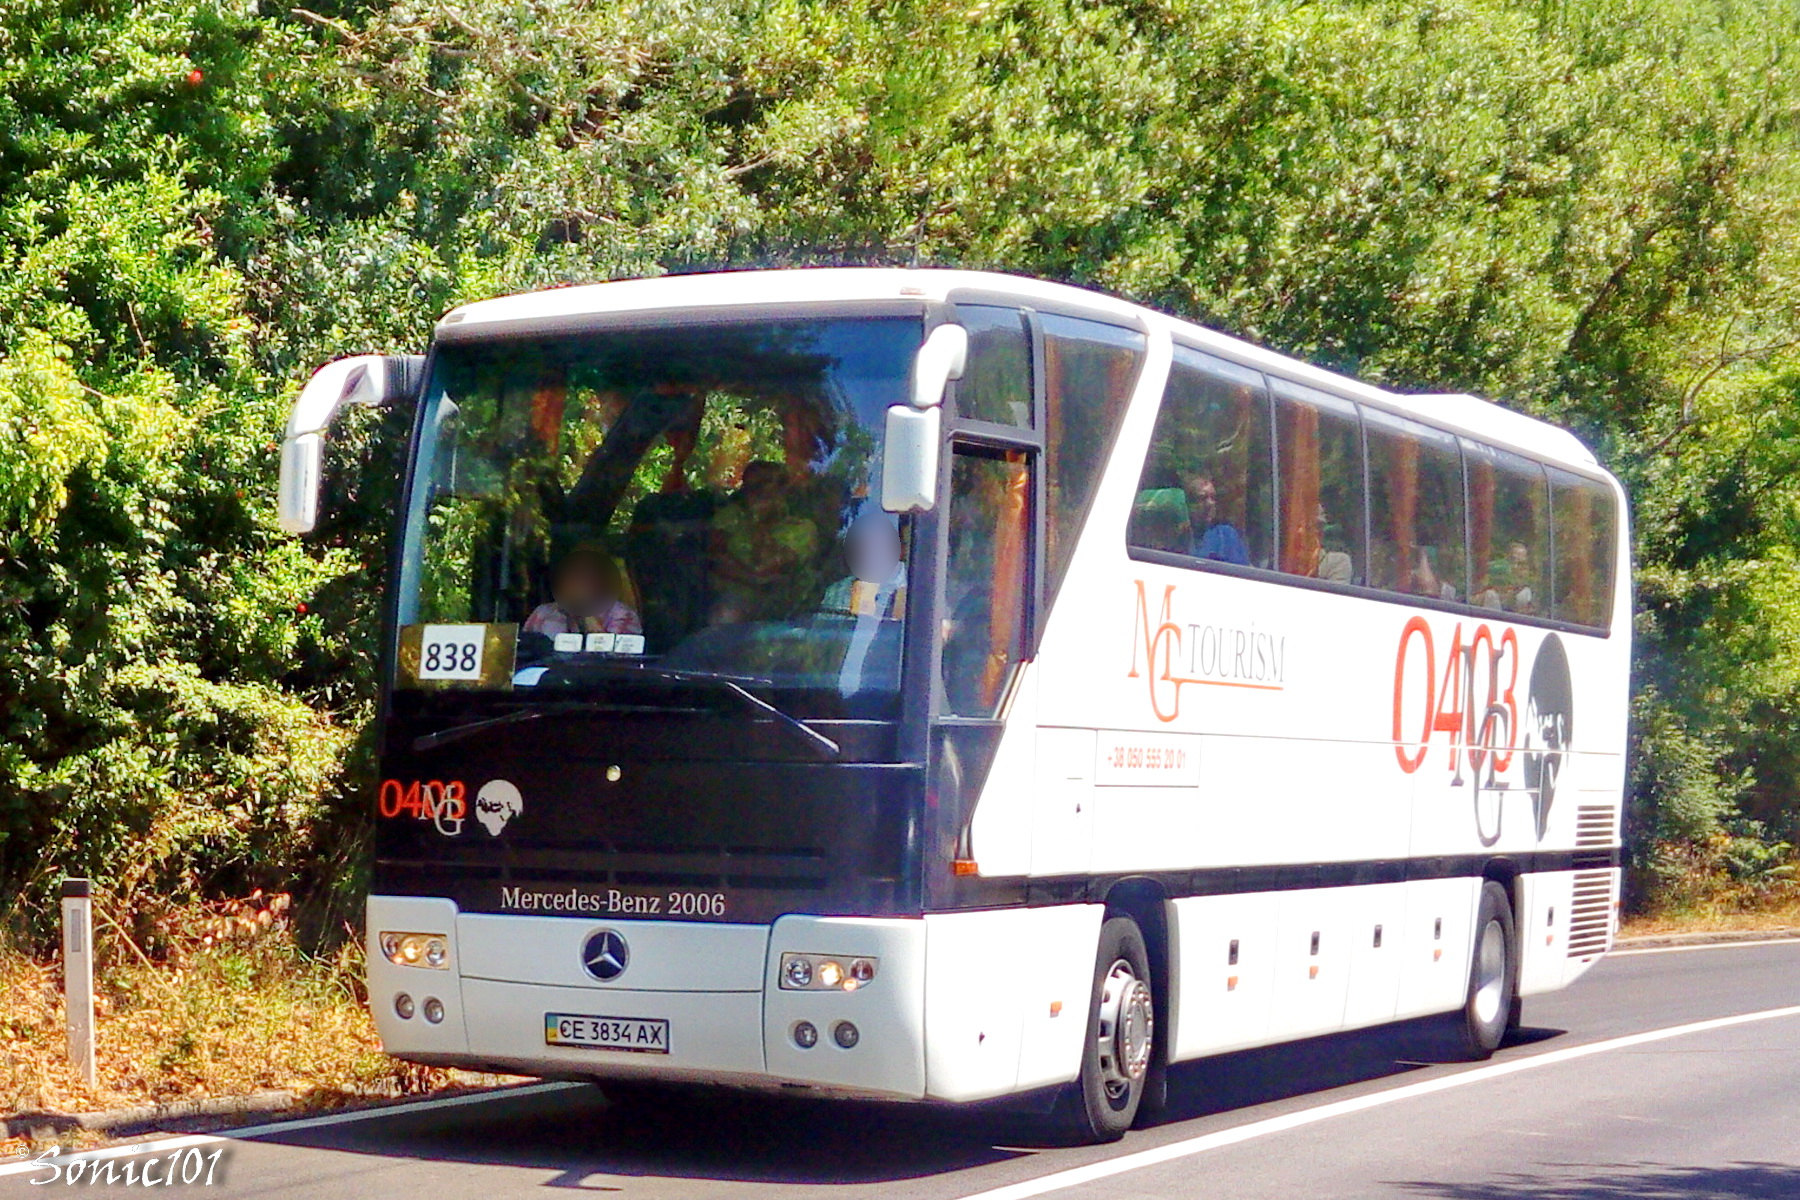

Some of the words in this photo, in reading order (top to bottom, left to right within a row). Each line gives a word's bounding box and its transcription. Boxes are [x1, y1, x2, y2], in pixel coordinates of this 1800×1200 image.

[425, 643, 477, 672] 838
[1127, 747, 1143, 768] 050
[1146, 748, 1162, 769] 555
[1164, 748, 1175, 769] 20
[1176, 749, 1186, 769] 01
[500, 886, 661, 914] Mercedes-Benz
[668, 892, 725, 916] 2006
[590, 1021, 631, 1043] 3834
[636, 1024, 663, 1045] AX
